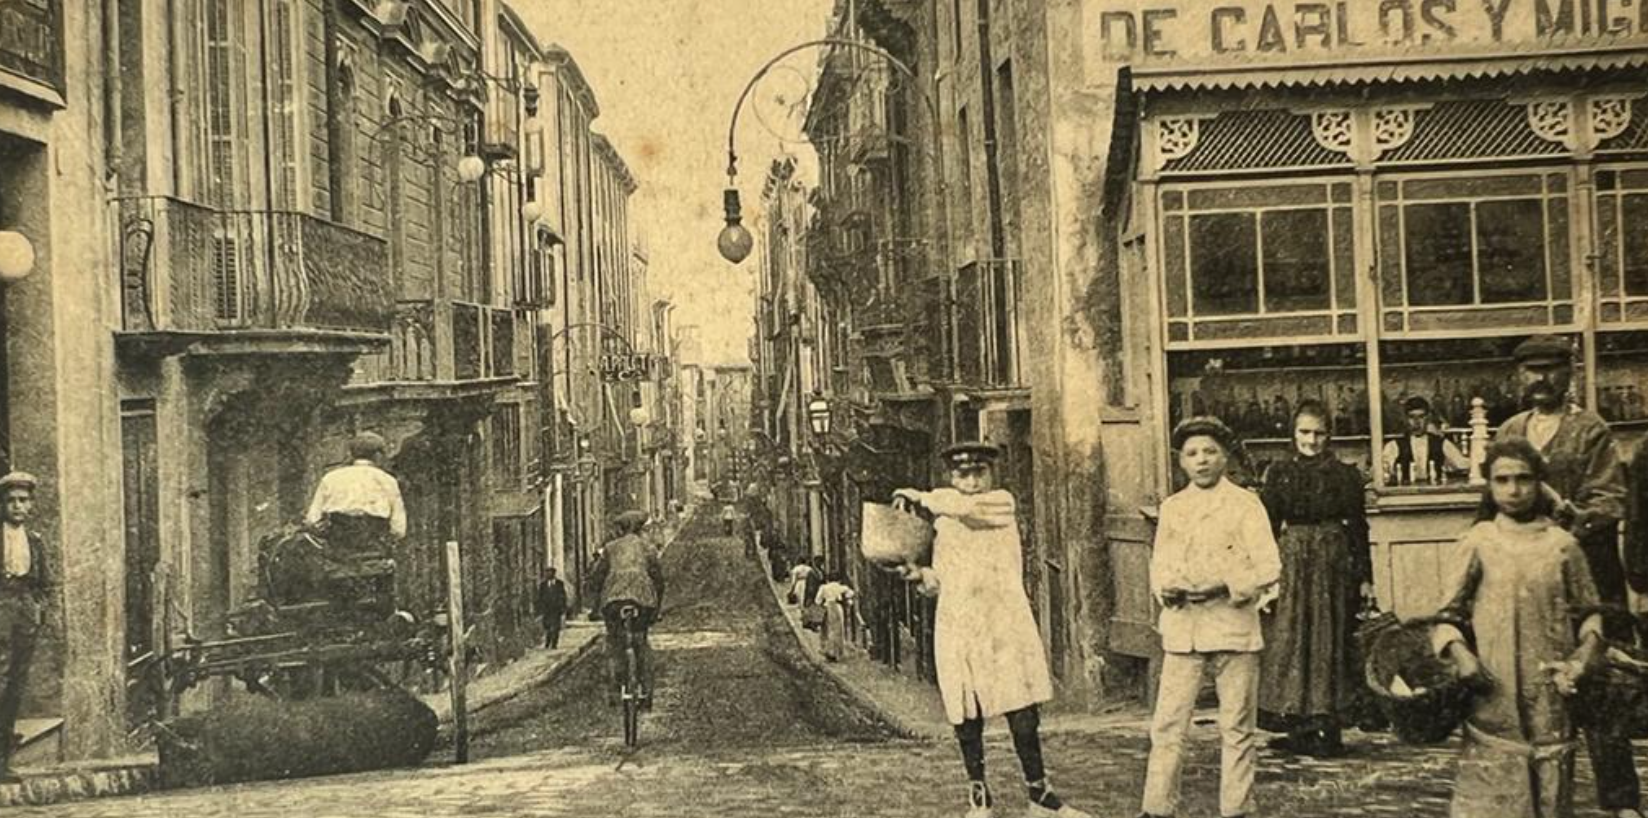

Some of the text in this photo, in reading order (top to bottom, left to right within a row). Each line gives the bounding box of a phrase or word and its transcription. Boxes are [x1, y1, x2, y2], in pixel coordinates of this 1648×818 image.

[1100, 0, 1648, 61] DE CARLOS Y MIG
